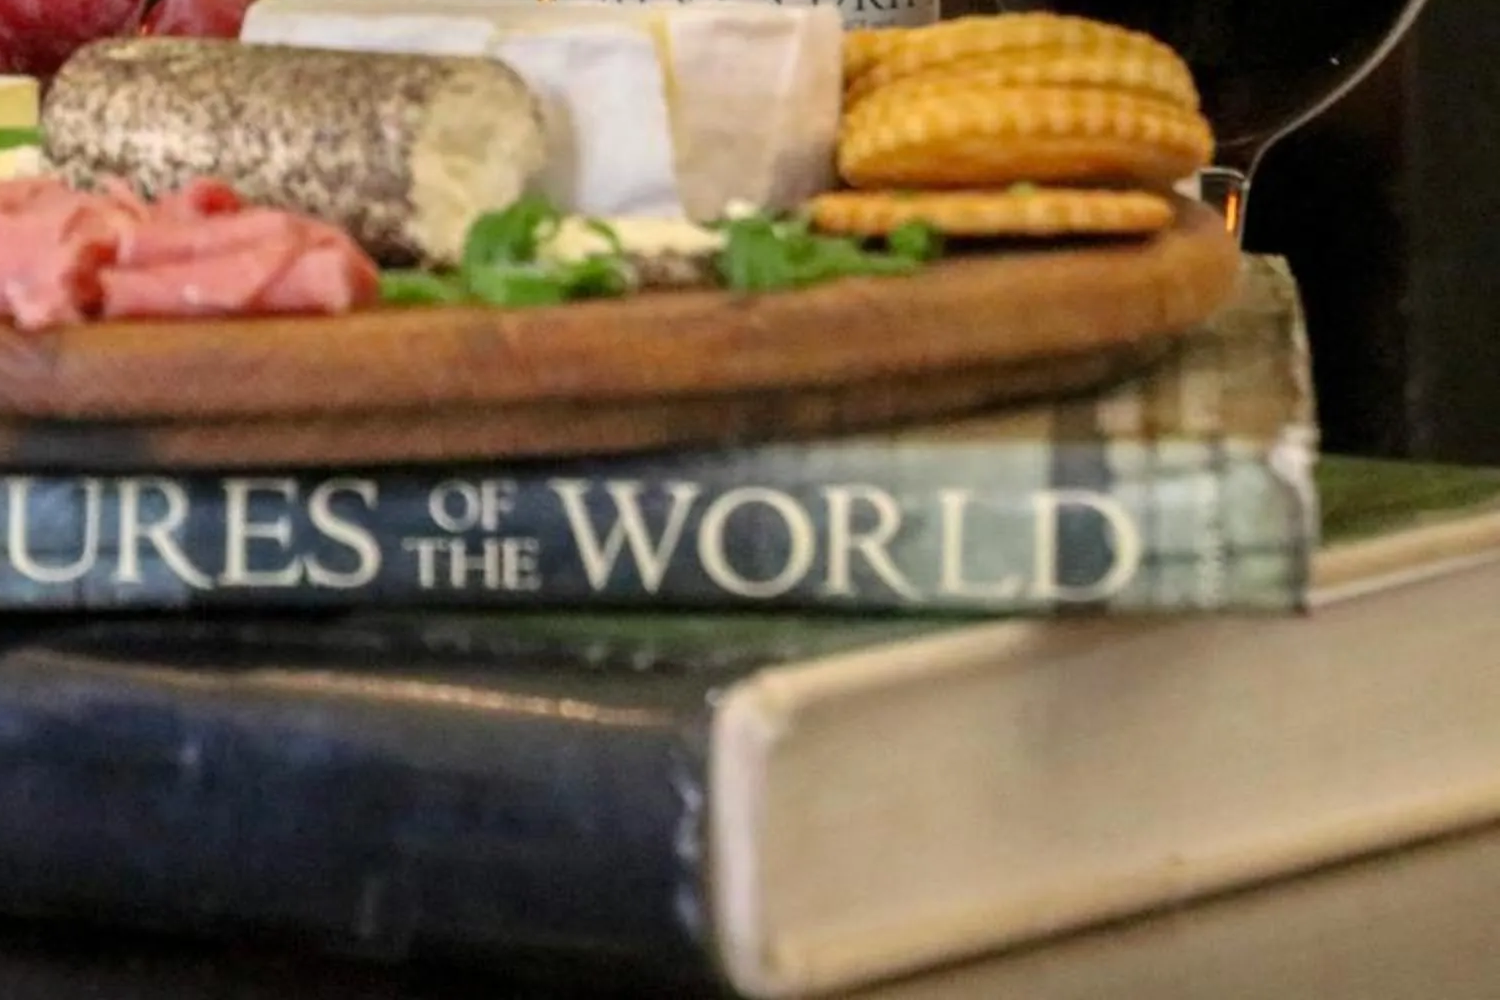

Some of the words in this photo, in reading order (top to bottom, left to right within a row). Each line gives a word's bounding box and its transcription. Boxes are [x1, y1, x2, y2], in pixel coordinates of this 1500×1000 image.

[428, 480, 515, 531] OF
[404, 537, 540, 592] THE
[551, 478, 1141, 600] WORLD
